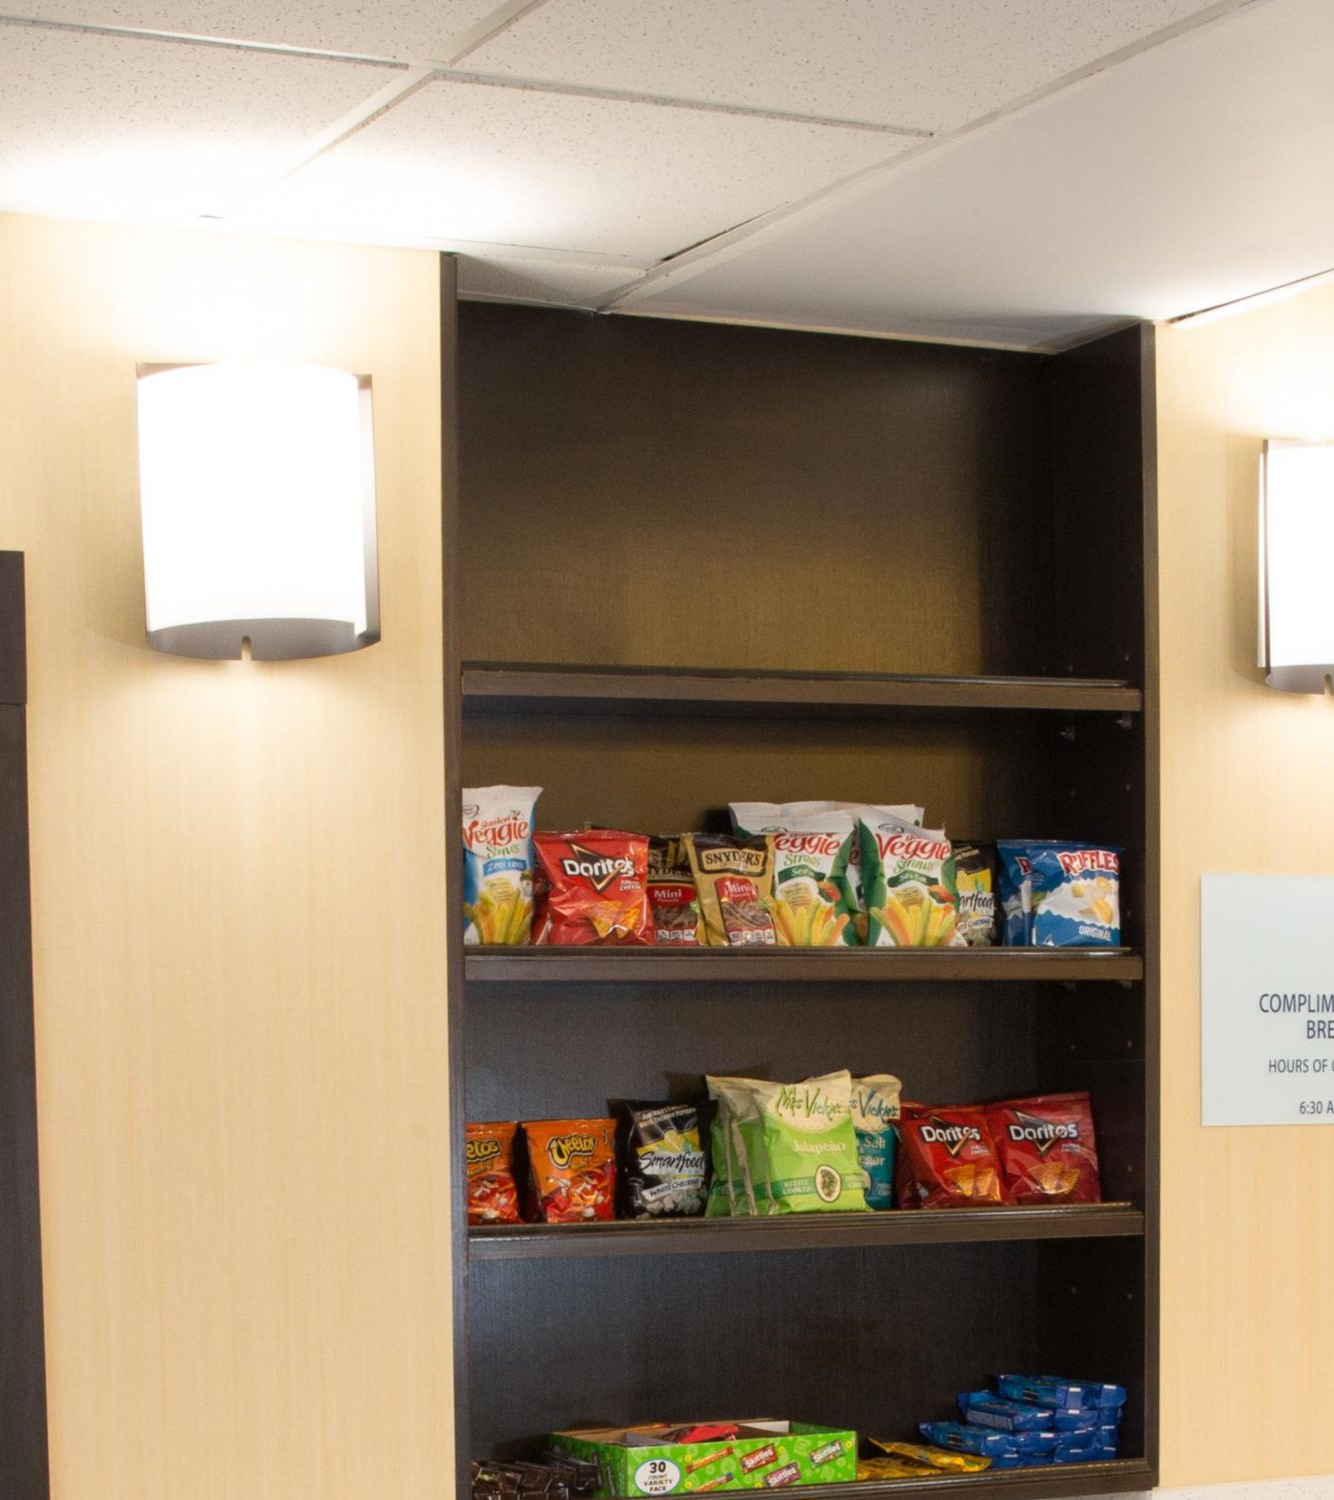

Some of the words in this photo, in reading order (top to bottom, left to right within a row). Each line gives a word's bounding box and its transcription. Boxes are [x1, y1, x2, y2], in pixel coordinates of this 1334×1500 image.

[463, 820, 529, 850] Veggie
[875, 832, 950, 861] Veggie
[562, 858, 635, 878] Doritos
[1057, 850, 1120, 876] RUFFLES
[654, 889, 682, 899] Mini
[959, 891, 995, 912] artfood
[1268, 1059, 1309, 1073] HOURS
[1312, 1059, 1328, 1073] OF
[1299, 1101, 1323, 1115] 6:30
[920, 1125, 980, 1142] Doritos
[1009, 1123, 1077, 1140] Doritos
[467, 1139, 501, 1159] etos
[549, 1135, 596, 1167] Cheetos
[639, 1151, 705, 1173] Smartfood
[649, 1461, 666, 1474] 30
[744, 1447, 775, 1469] Skittles
